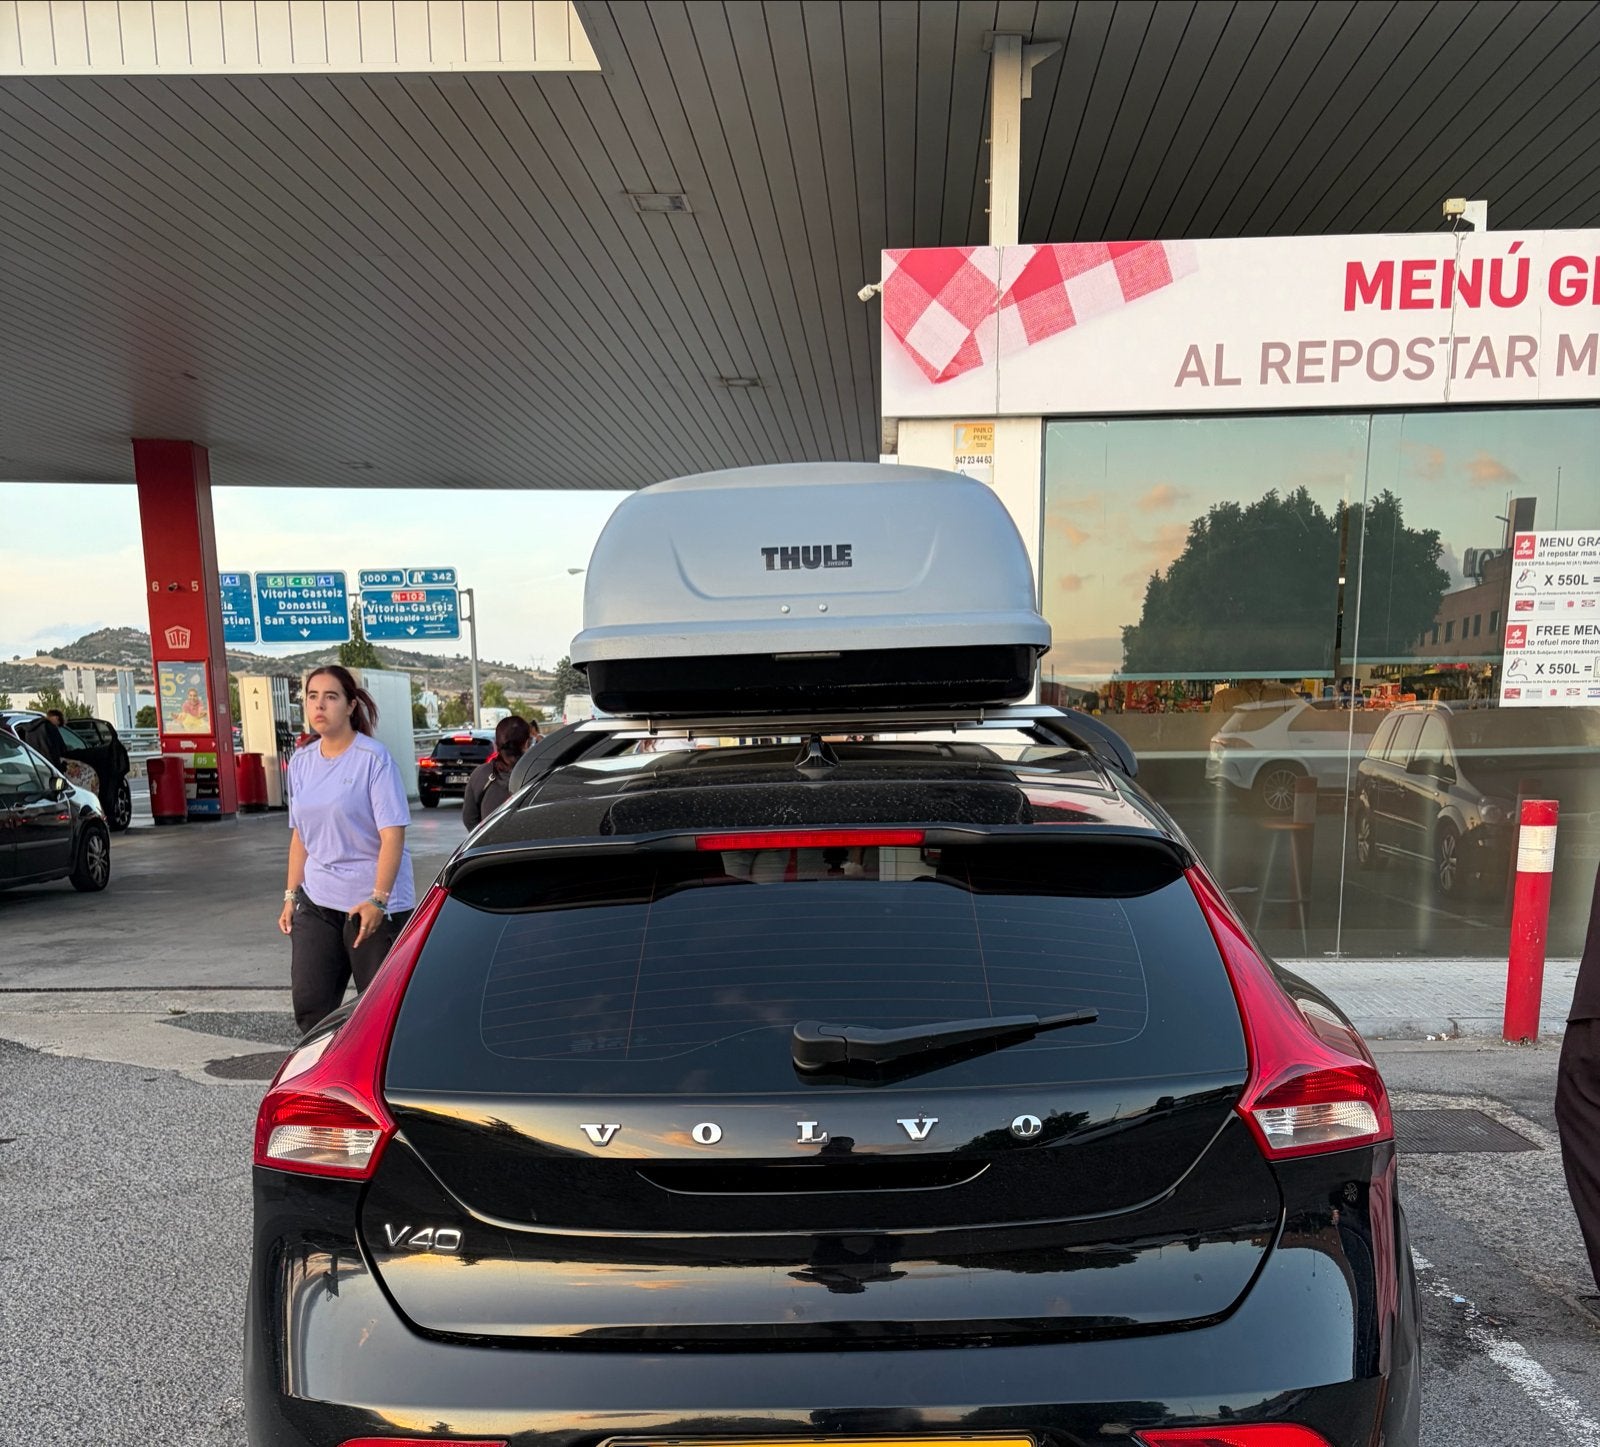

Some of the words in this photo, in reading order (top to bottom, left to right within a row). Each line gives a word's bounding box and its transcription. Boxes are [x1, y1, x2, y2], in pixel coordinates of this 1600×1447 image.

[1344, 240, 1531, 312] MENÚ
[1173, 343, 1242, 388] AL
[1259, 335, 1539, 385] REPOSTAR
[1556, 333, 1599, 376] M
[955, 456, 966, 464] 947
[968, 456, 975, 464] 23
[976, 456, 984, 464] 44
[984, 456, 992, 464] 63
[1539, 536, 1574, 547] MENU
[760, 544, 852, 570] THULE
[1547, 550, 1579, 558] repostar
[432, 572, 452, 580] 342
[1558, 574, 1589, 586] 550L
[152, 580, 160, 592] 6
[191, 580, 199, 592] 5
[261, 589, 343, 599] Vitoria-Gasteiz
[394, 592, 425, 600] N-102
[278, 600, 328, 610] Donostia
[368, 602, 454, 613] Vitoria-Gasteiz
[264, 616, 285, 625] San
[290, 616, 344, 625] Sebastian
[1536, 626, 1570, 636] FREE
[1548, 663, 1580, 674] 550L
[580, 1114, 1042, 1147] VOLVO
[384, 1223, 463, 1251] V40
